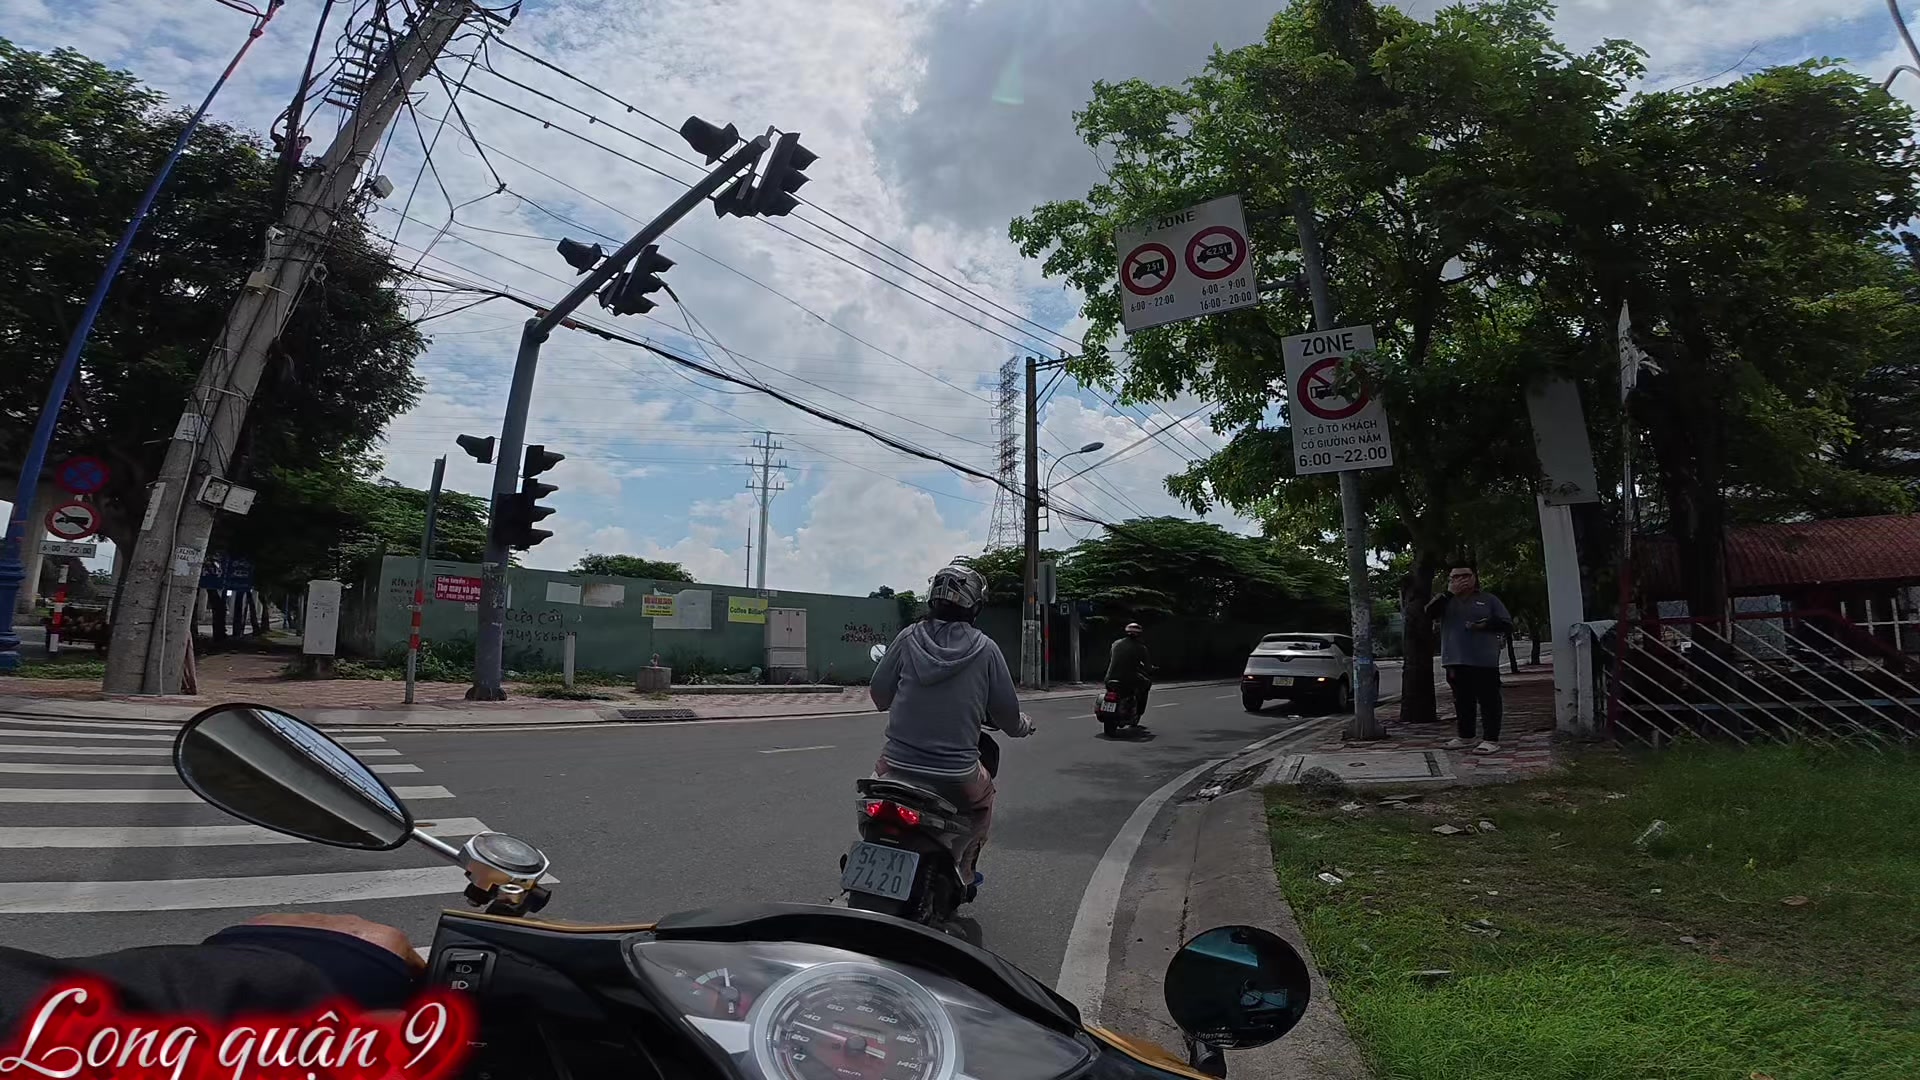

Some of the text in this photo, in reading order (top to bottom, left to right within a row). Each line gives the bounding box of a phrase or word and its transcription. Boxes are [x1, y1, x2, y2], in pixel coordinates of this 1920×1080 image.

[1157, 210, 1196, 230] ZONE
[1202, 283, 1218, 295] 6:00
[1228, 277, 1246, 290] 9:00
[1131, 300, 1146, 312] 6:00
[1154, 294, 1175, 307] 22:00
[1200, 298, 1221, 310] 16:00
[1229, 291, 1252, 304] 20:00
[1301, 332, 1355, 357] ZONE
[1302, 426, 1314, 436] XE
[1341, 418, 1377, 431] KHÁCH
[1301, 438, 1315, 450] CÓ
[1299, 452, 1331, 467] 6:00
[850, 866, 902, 894] 7420
[804, 1012, 822, 1021] 40
[878, 1015, 898, 1024] 100
[896, 1060, 918, 1069] 140
